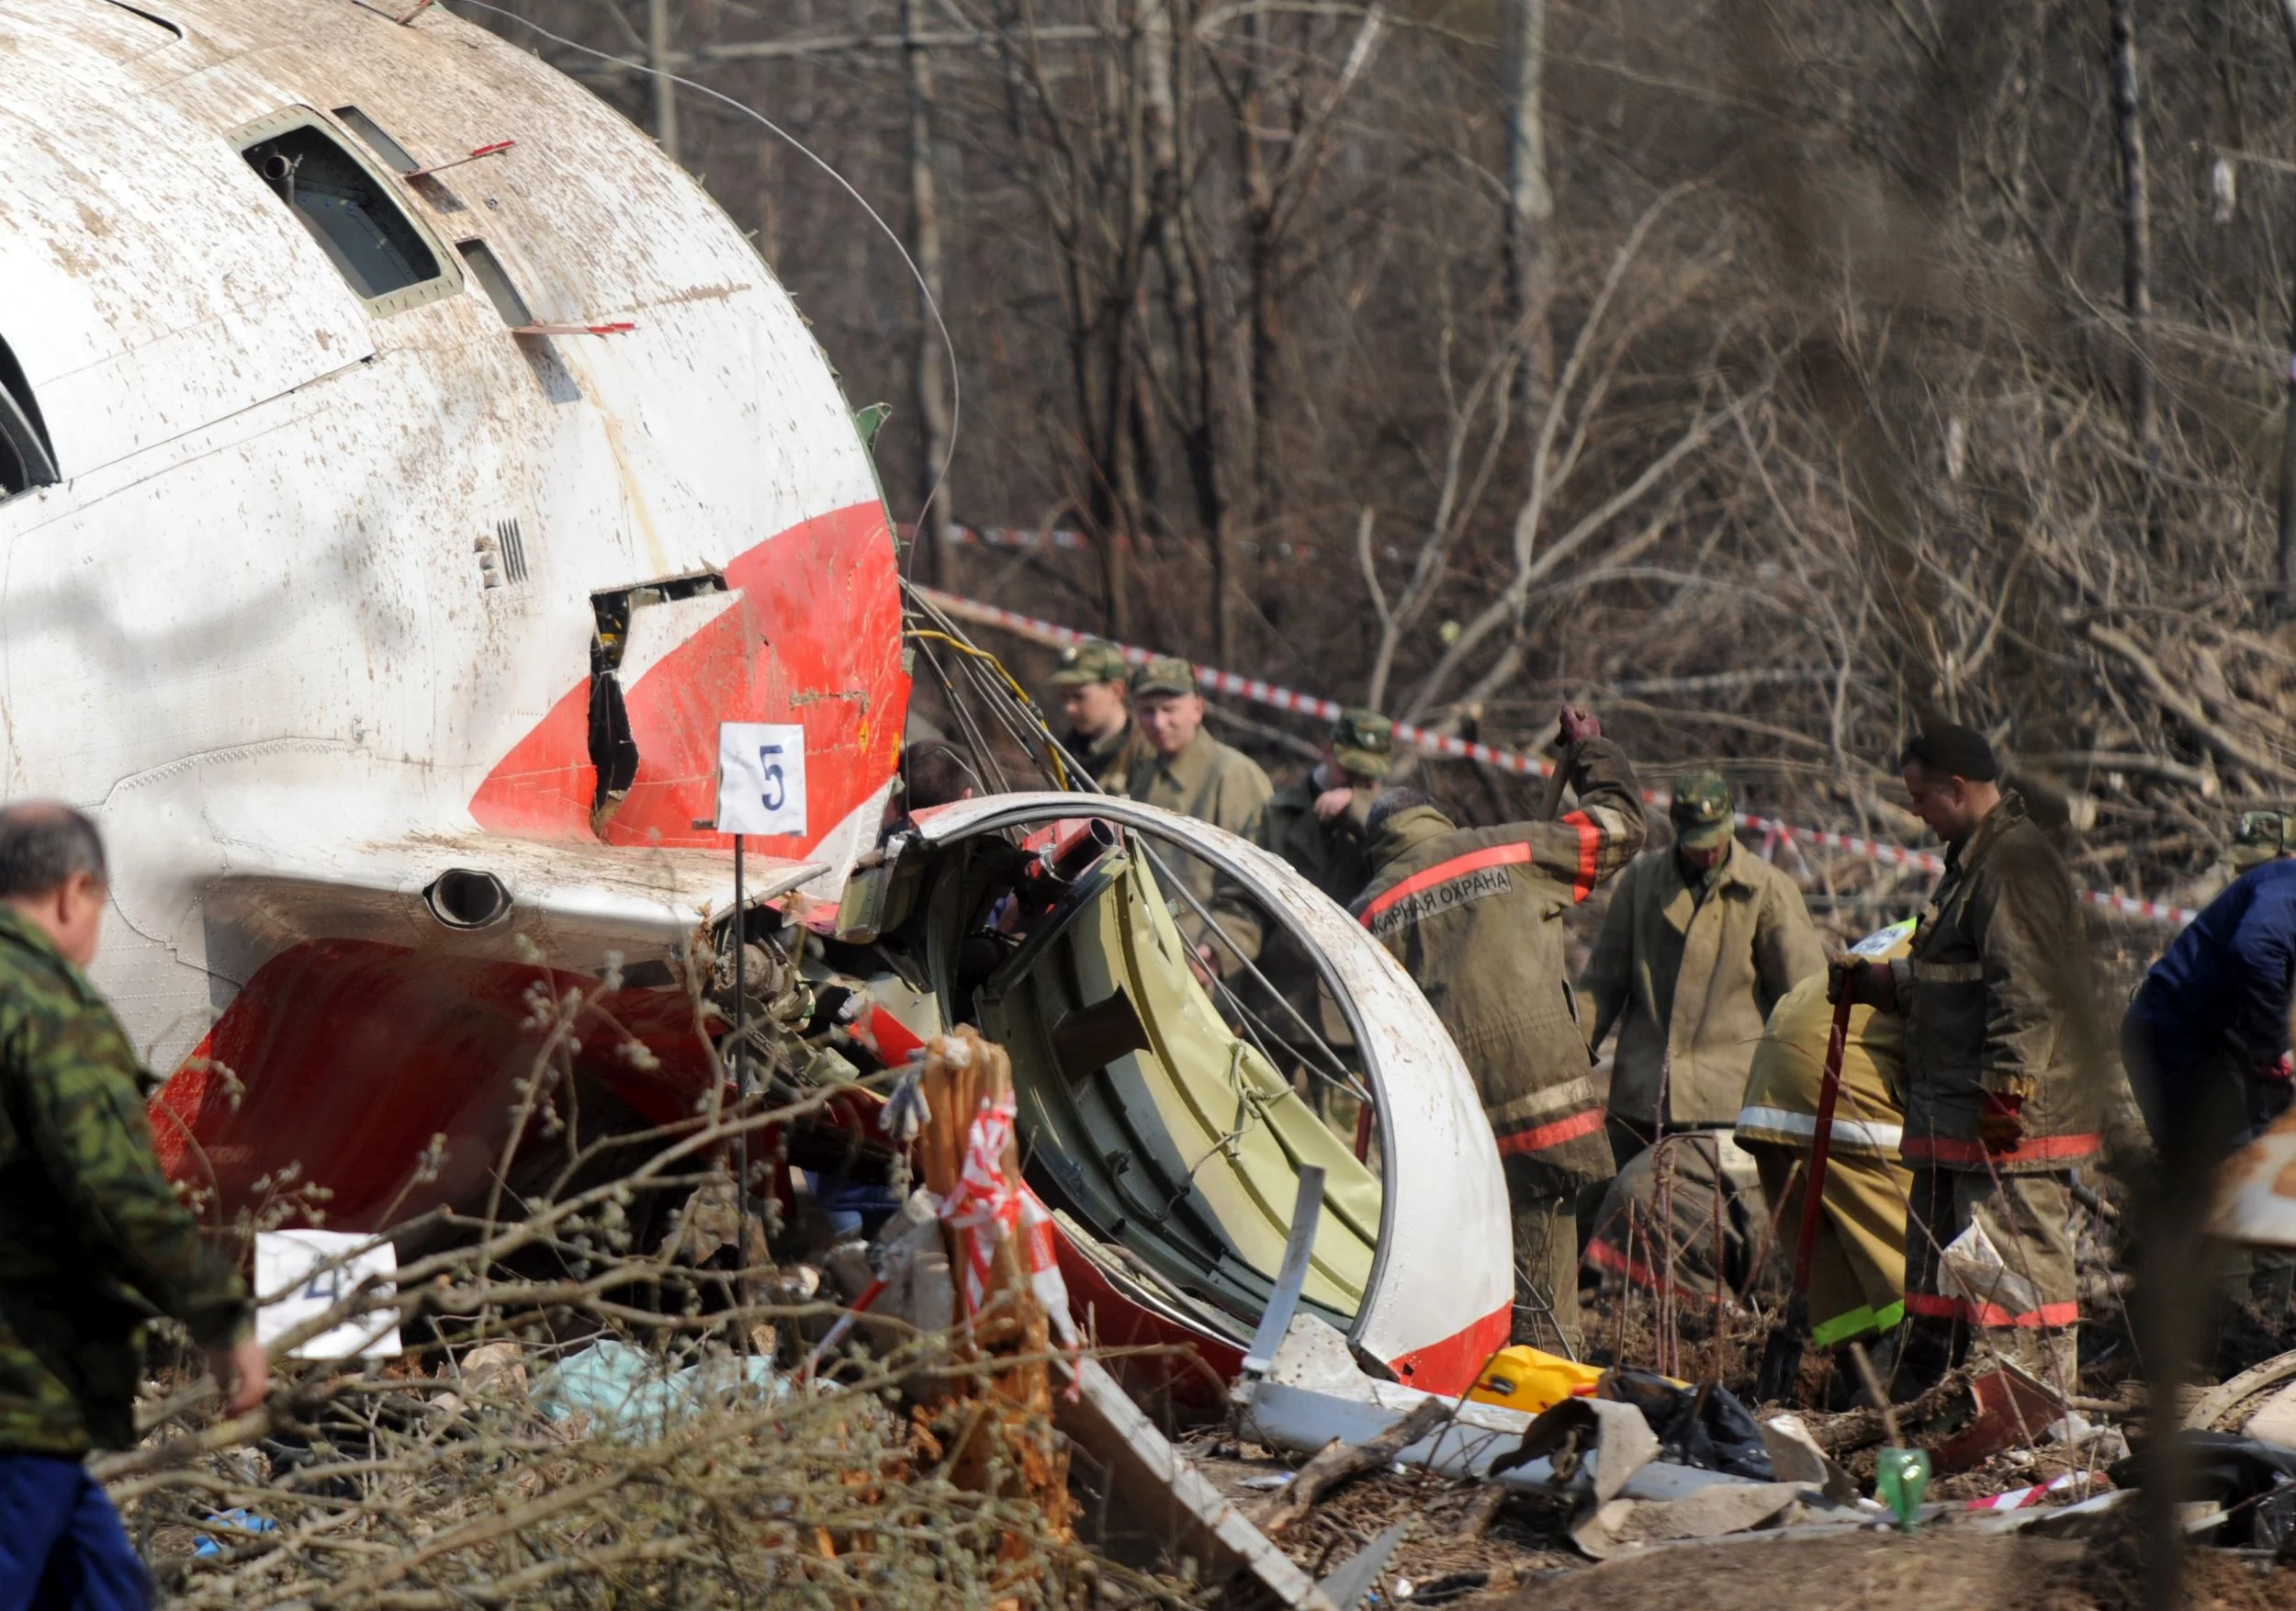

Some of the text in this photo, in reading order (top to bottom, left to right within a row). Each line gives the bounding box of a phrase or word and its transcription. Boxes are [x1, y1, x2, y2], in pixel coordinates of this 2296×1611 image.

[760, 744, 785, 812] 5
[1439, 871, 1509, 904] ОХРАНА
[304, 1254, 340, 1332] 4
